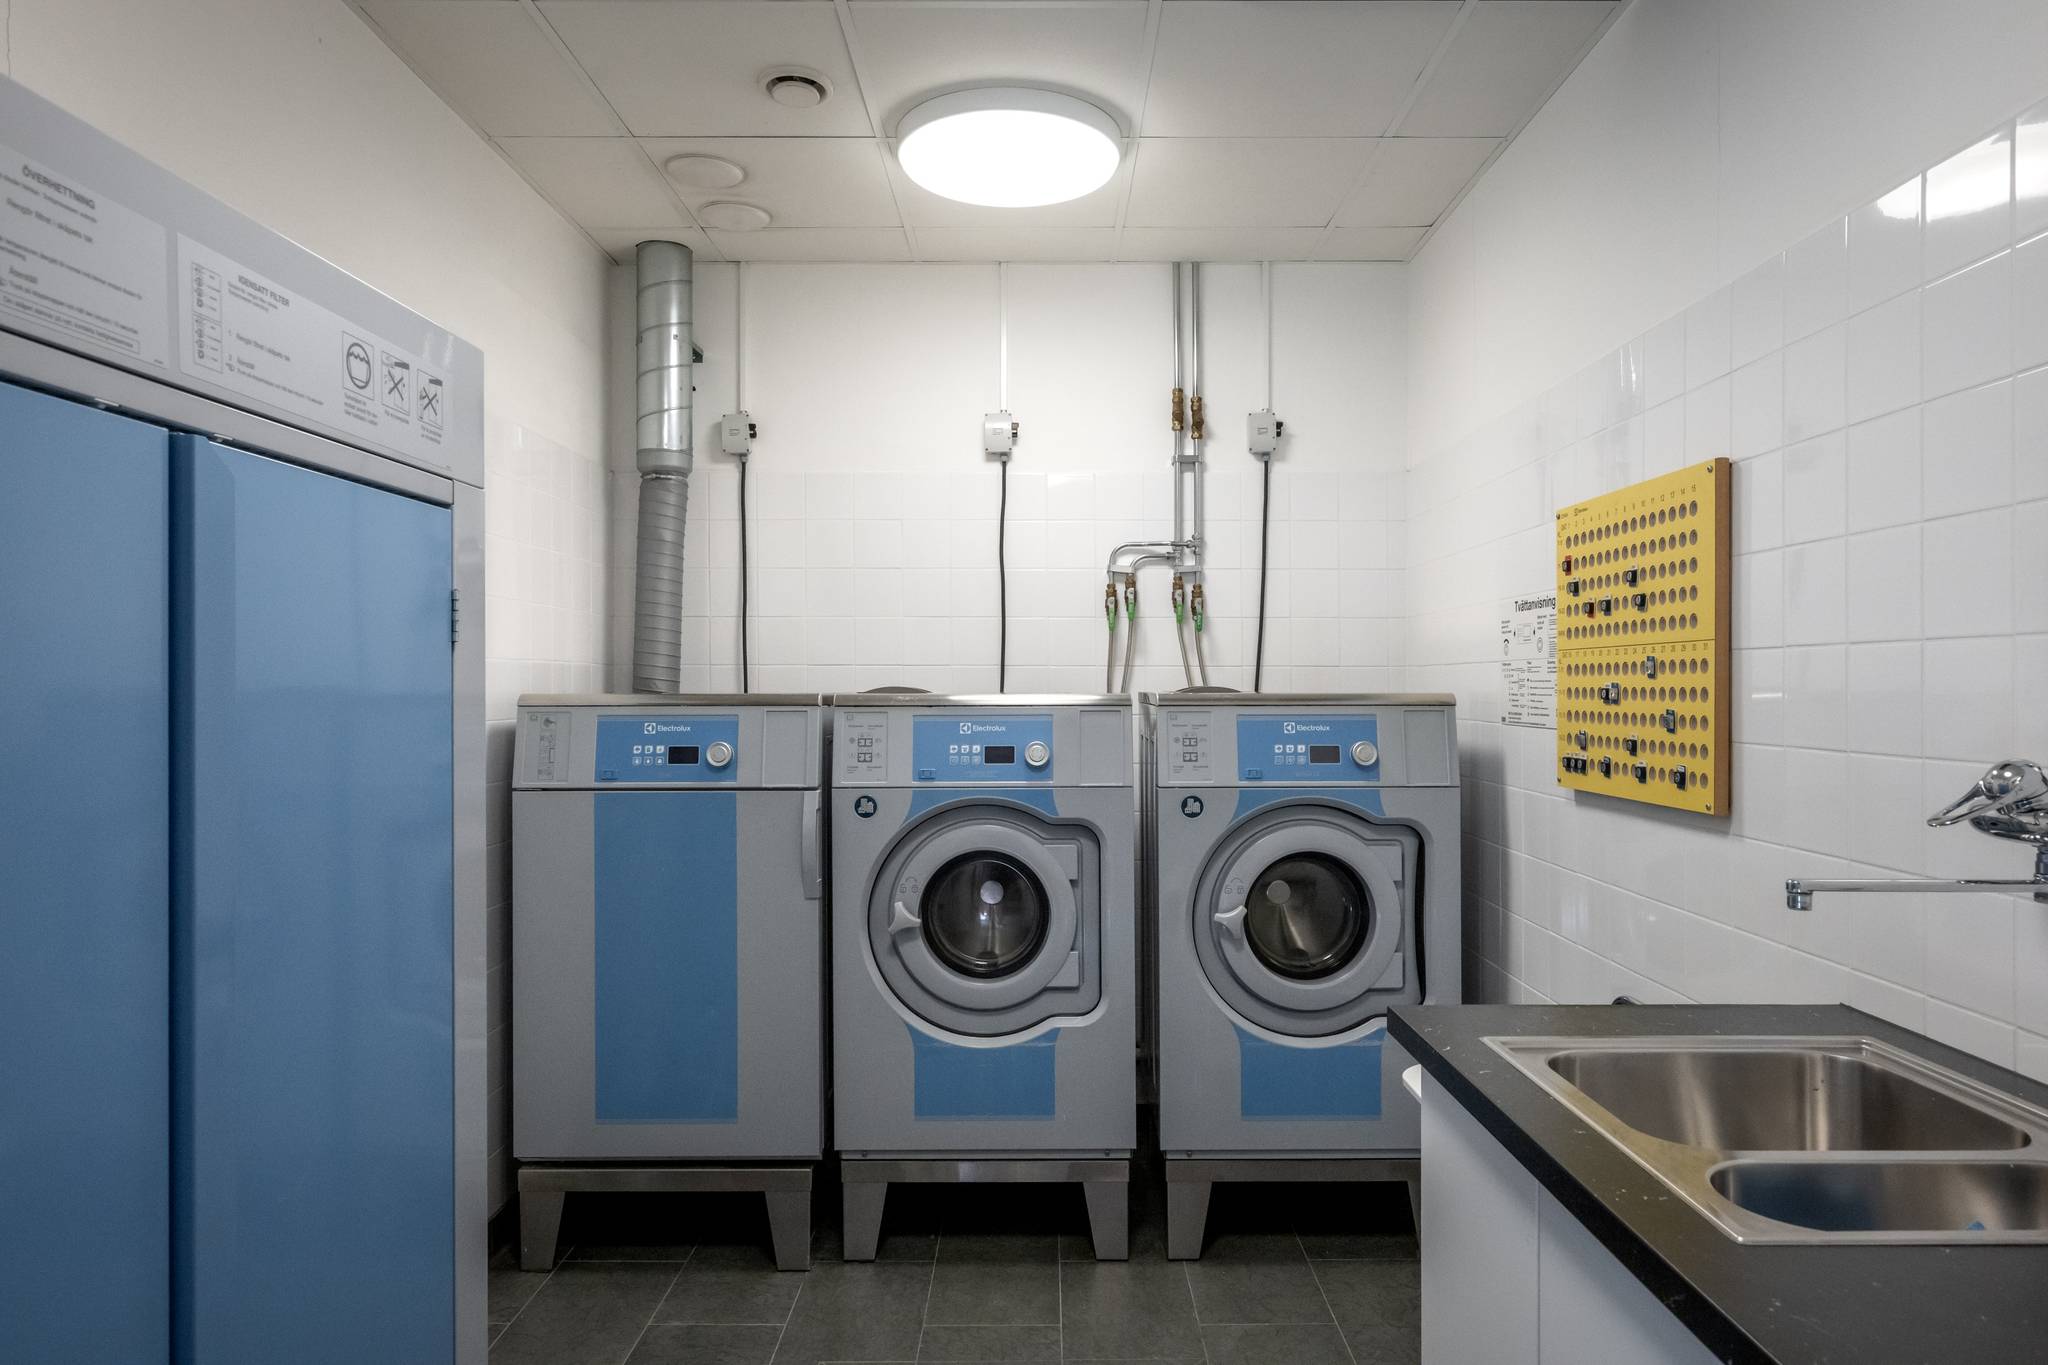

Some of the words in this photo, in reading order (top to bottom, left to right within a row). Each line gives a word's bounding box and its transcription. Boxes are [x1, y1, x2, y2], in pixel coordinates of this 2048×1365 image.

[22, 165, 95, 209] ÖVERHETTNING
[269, 290, 290, 307] FILTER
[1514, 595, 1556, 613] Tvättanvisning
[657, 724, 691, 732] Electrolux
[972, 724, 1006, 732] Electrolux
